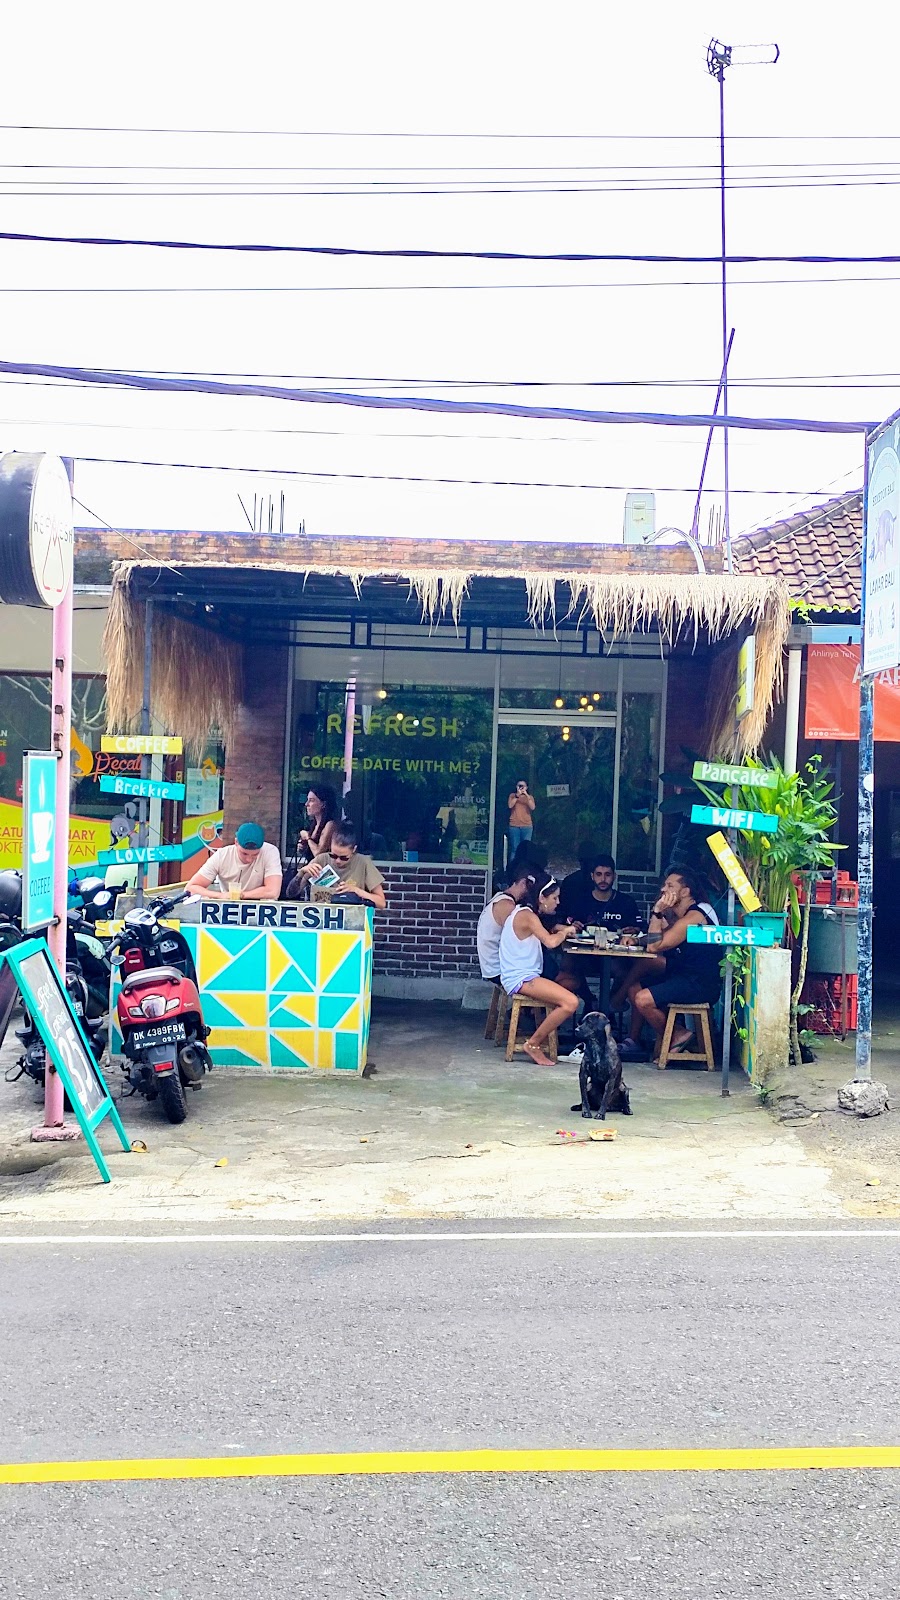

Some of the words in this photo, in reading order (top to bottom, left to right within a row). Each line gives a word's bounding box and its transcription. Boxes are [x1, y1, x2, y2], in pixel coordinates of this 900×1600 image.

[811, 650, 839, 659] Ahlinya
[326, 713, 459, 739] REFRESH
[115, 737, 169, 753] COFFEE
[301, 755, 359, 772] COFFEE
[363, 757, 401, 772] DATE
[405, 759, 444, 773] WITH
[449, 760, 480, 774] ME?
[701, 765, 769, 787] Pancake
[114, 779, 169, 798] Brekkie
[454, 796, 475, 804] MEET
[475, 796, 486, 804] US
[712, 808, 754, 830] WIFI
[115, 847, 156, 863] LOVE
[30, 876, 51, 898] COFFEE
[200, 902, 345, 931] REFRESH
[602, 911, 622, 921] itro
[702, 927, 756, 945] Toast
[134, 1031, 145, 1041] DK
